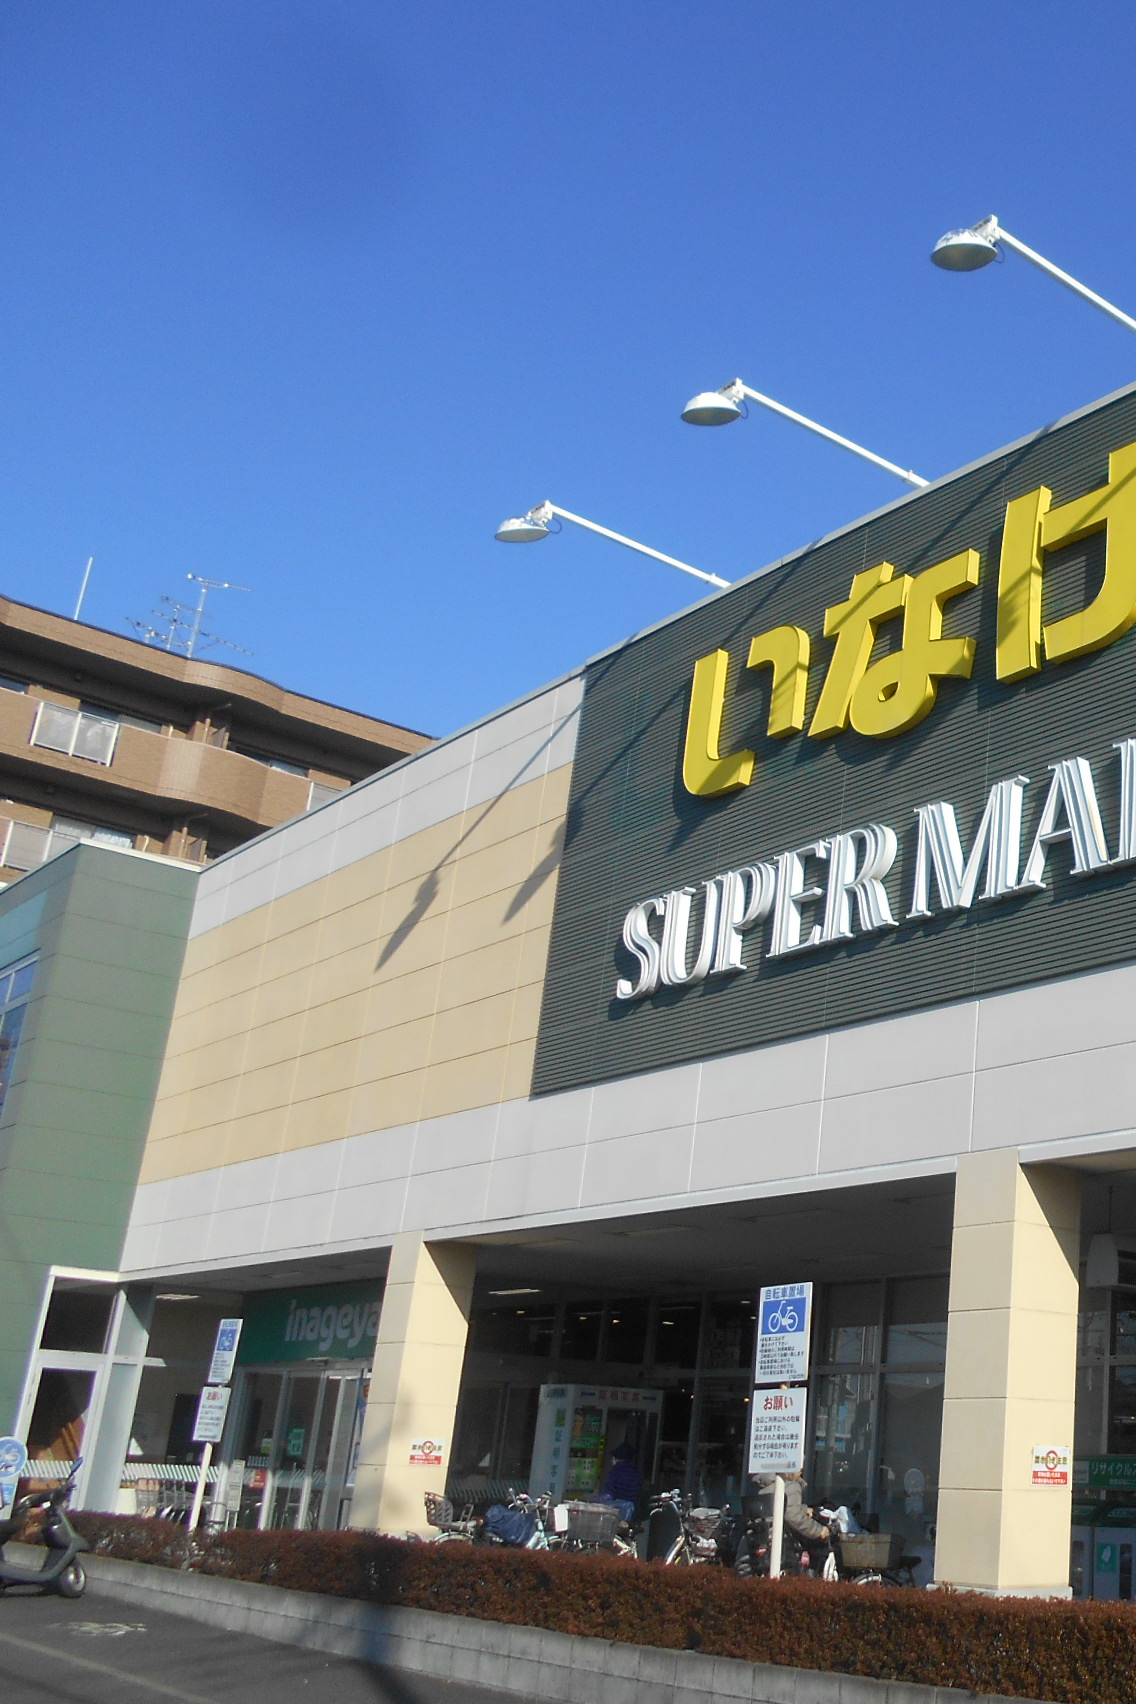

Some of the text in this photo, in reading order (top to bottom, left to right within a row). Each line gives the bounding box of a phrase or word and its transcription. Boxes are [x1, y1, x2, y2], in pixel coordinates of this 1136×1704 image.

[765, 1285, 804, 1300] 自転車置場
[284, 1298, 381, 1351] inageya
[763, 1396, 793, 1410] お願い
